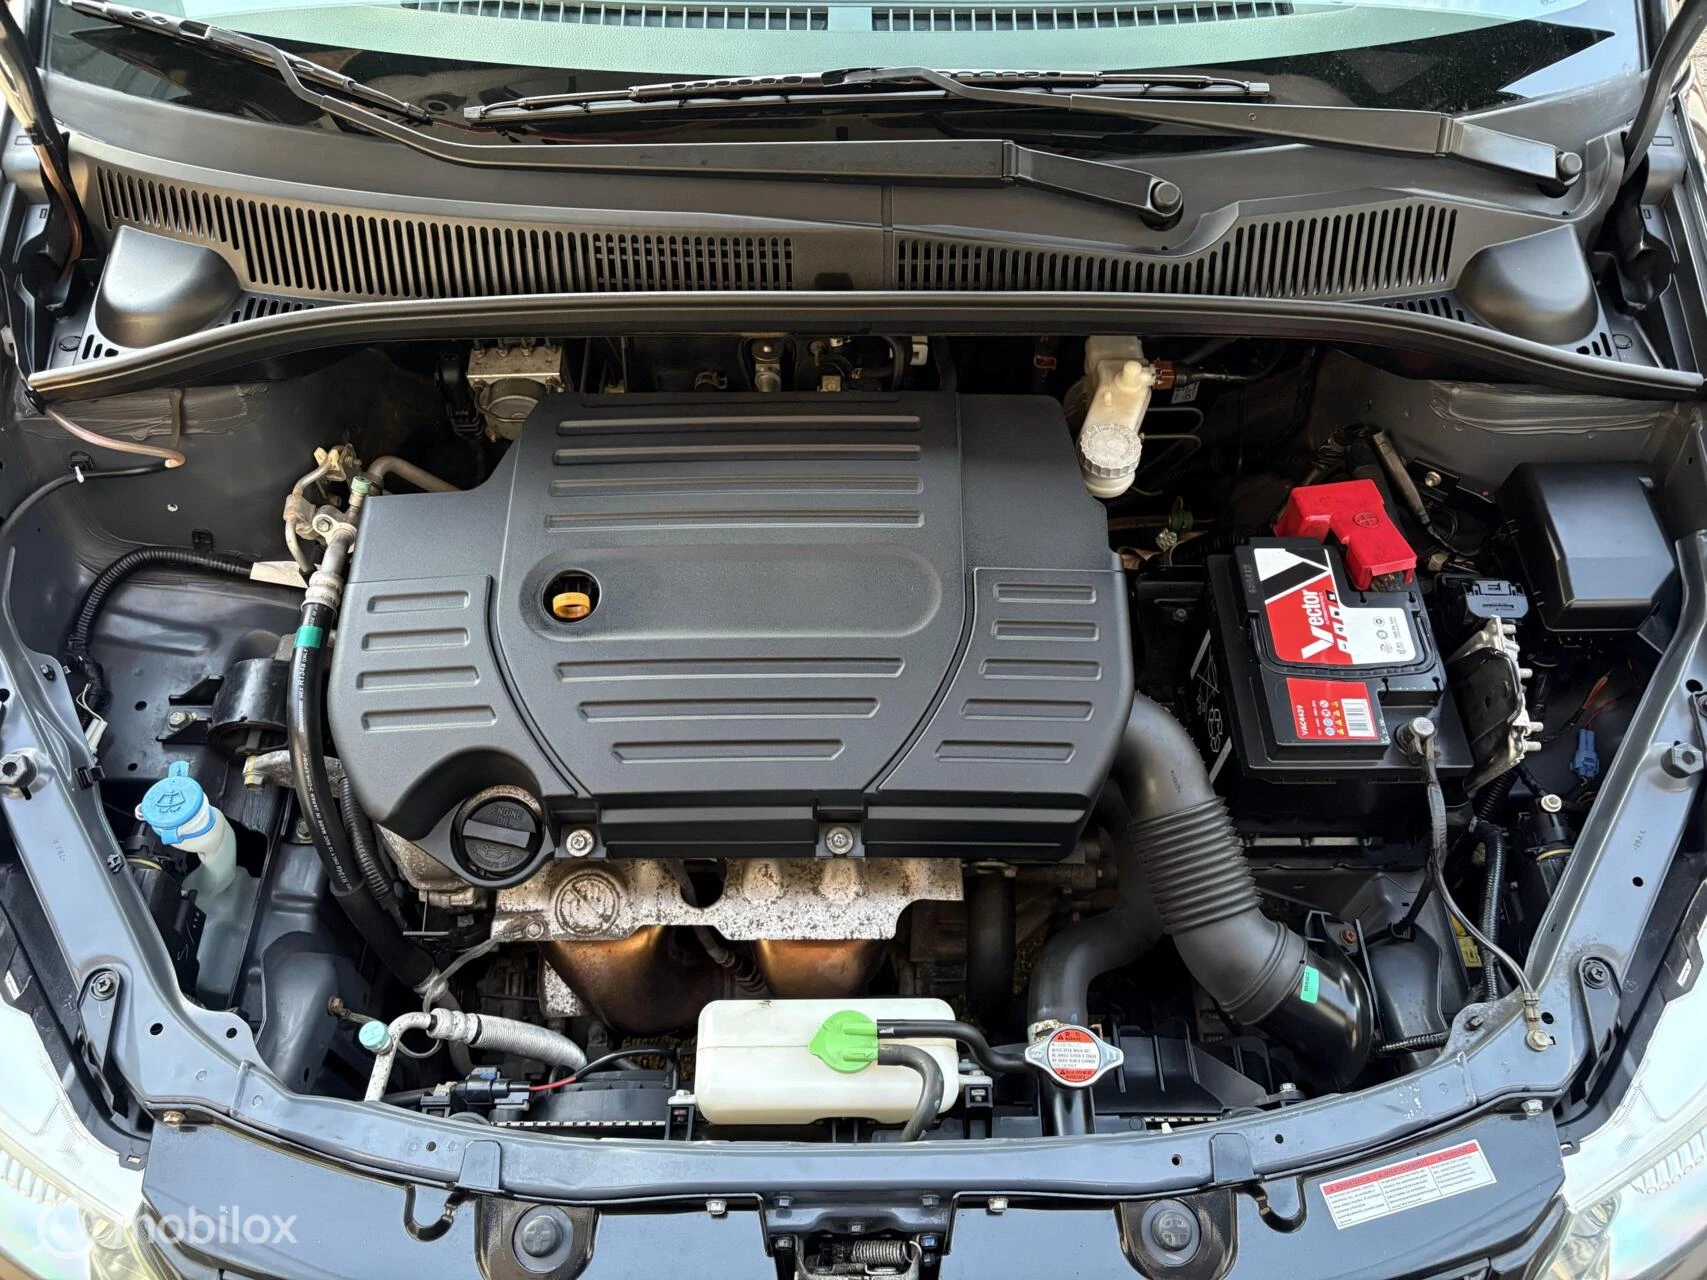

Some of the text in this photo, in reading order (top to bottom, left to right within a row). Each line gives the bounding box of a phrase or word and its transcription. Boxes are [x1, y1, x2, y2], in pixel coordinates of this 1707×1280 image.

[1300, 588, 1335, 659] Vector
[1296, 704, 1309, 736] VAC4439
[310, 793, 319, 811] JAPAN
[490, 806, 523, 819] ENGINE
[318, 820, 327, 835] MADE
[497, 816, 510, 826] OIL
